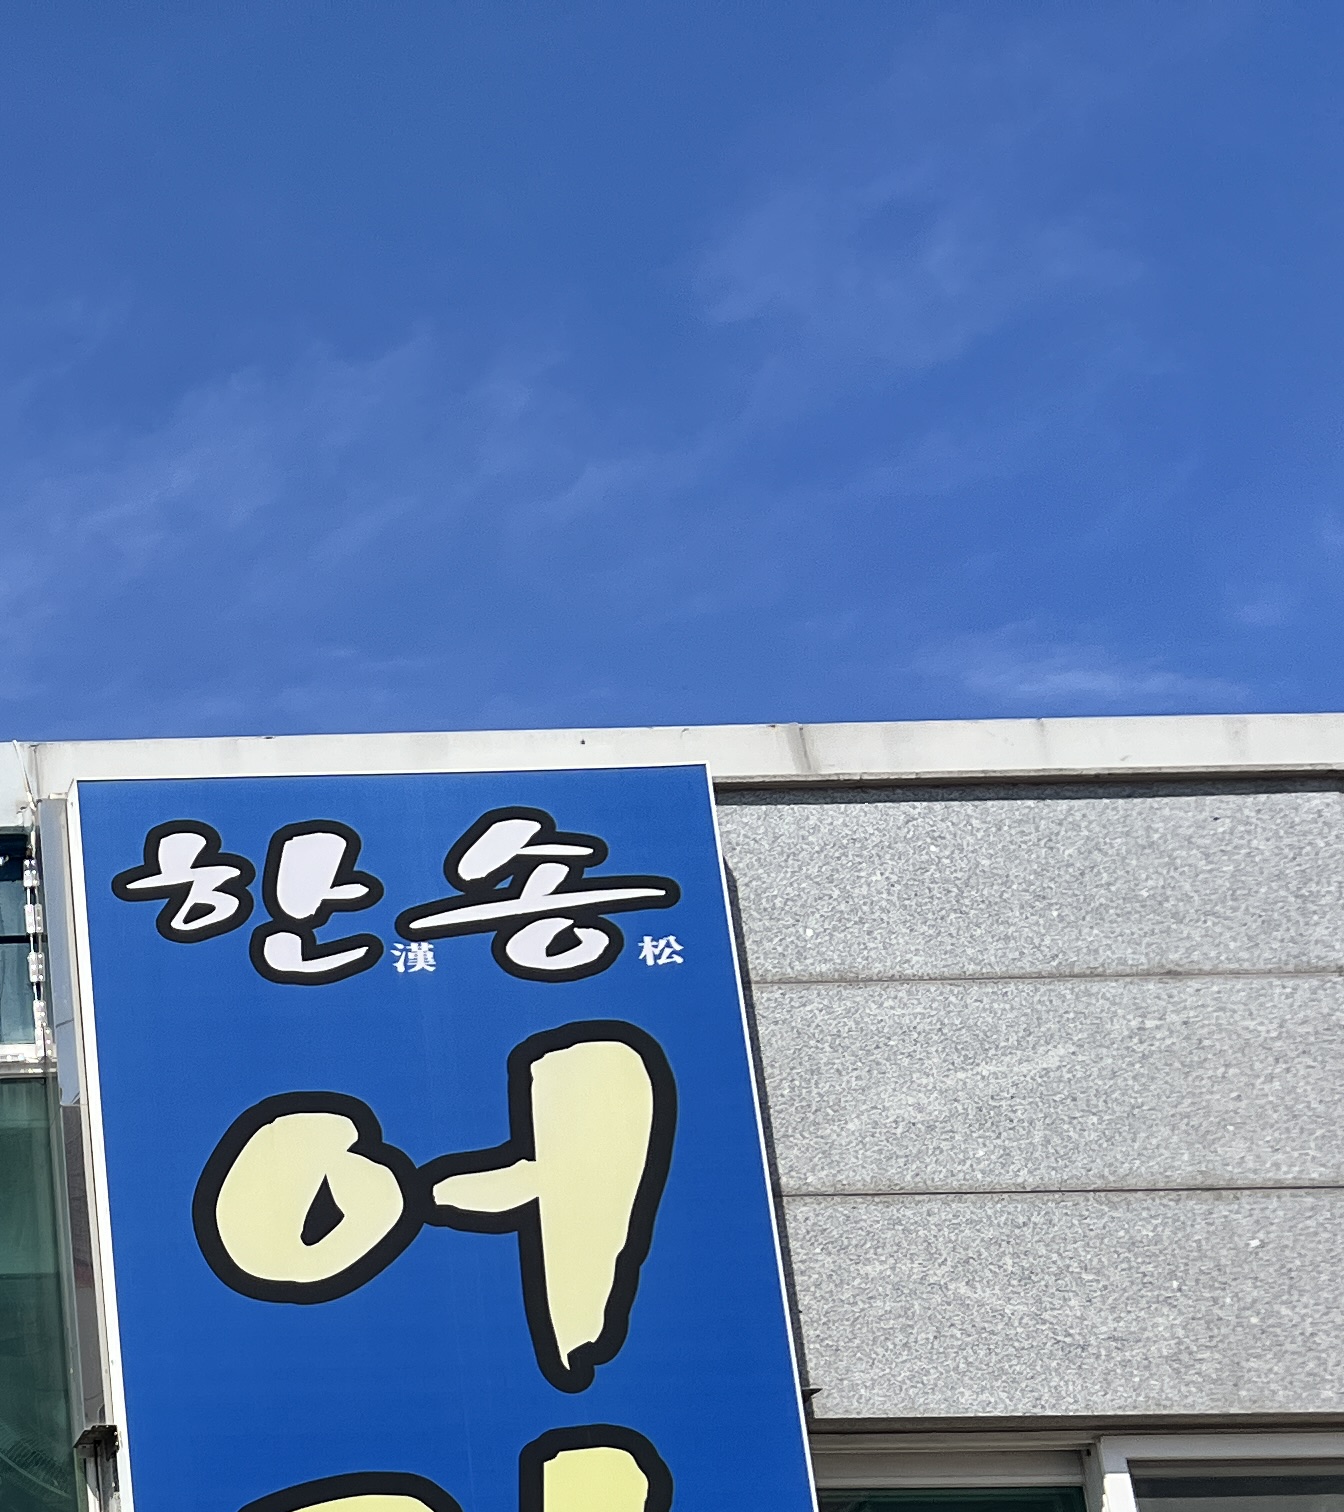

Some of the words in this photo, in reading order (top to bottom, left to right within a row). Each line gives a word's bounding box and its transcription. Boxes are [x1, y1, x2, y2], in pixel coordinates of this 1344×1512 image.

[113, 807, 680, 984] 한송
[390, 942, 437, 973] 漢
[638, 935, 685, 967] 松
